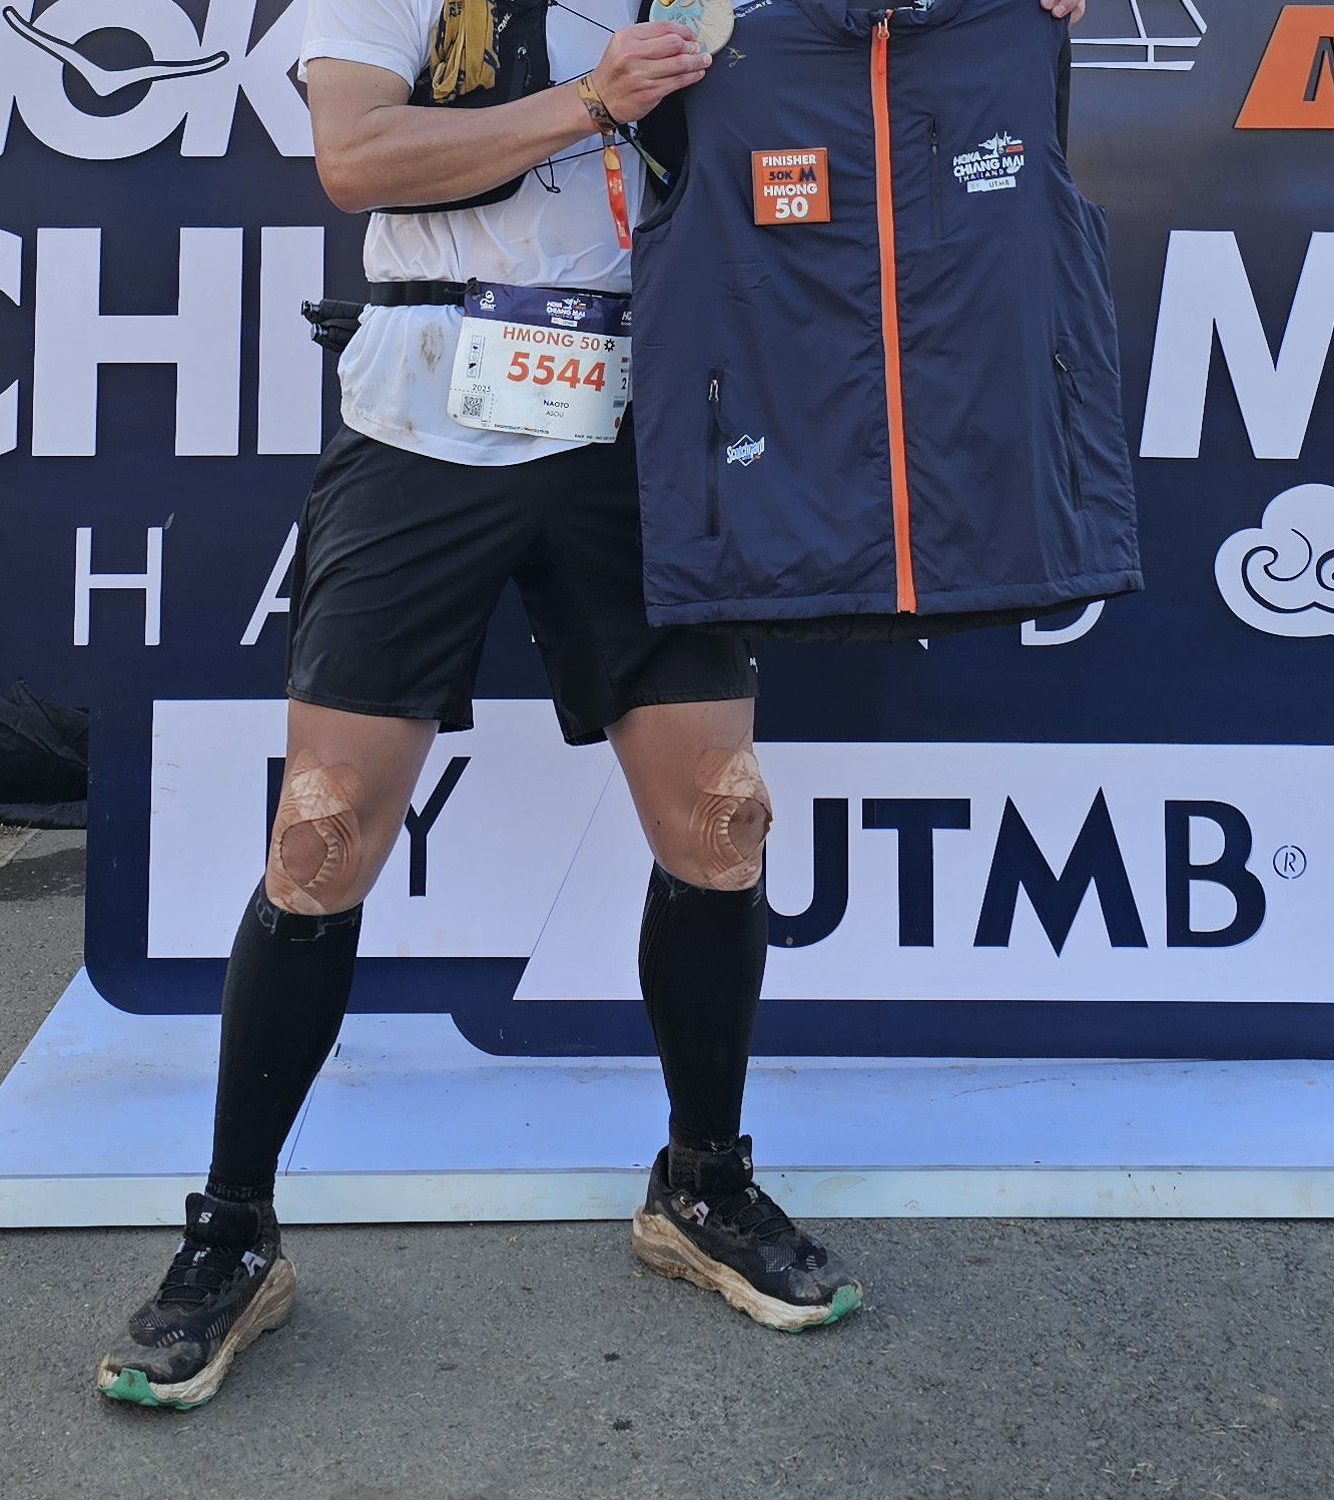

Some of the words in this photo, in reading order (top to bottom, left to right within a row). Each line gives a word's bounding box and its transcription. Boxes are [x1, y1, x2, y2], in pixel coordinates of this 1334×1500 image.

[762, 154, 817, 167] FINISHER
[953, 151, 982, 166] HOKA
[953, 159, 1000, 177] CHIANG
[1002, 154, 1025, 168] MAI
[768, 170, 793, 181] 50K
[763, 183, 818, 197] HMONG
[775, 196, 809, 219] 50
[502, 325, 575, 348] HMONG
[580, 336, 601, 351] 50
[506, 351, 606, 393] 5544
[472, 383, 492, 393] 2025
[543, 399, 570, 409] NAOTO
[545, 410, 565, 419] ASOU
